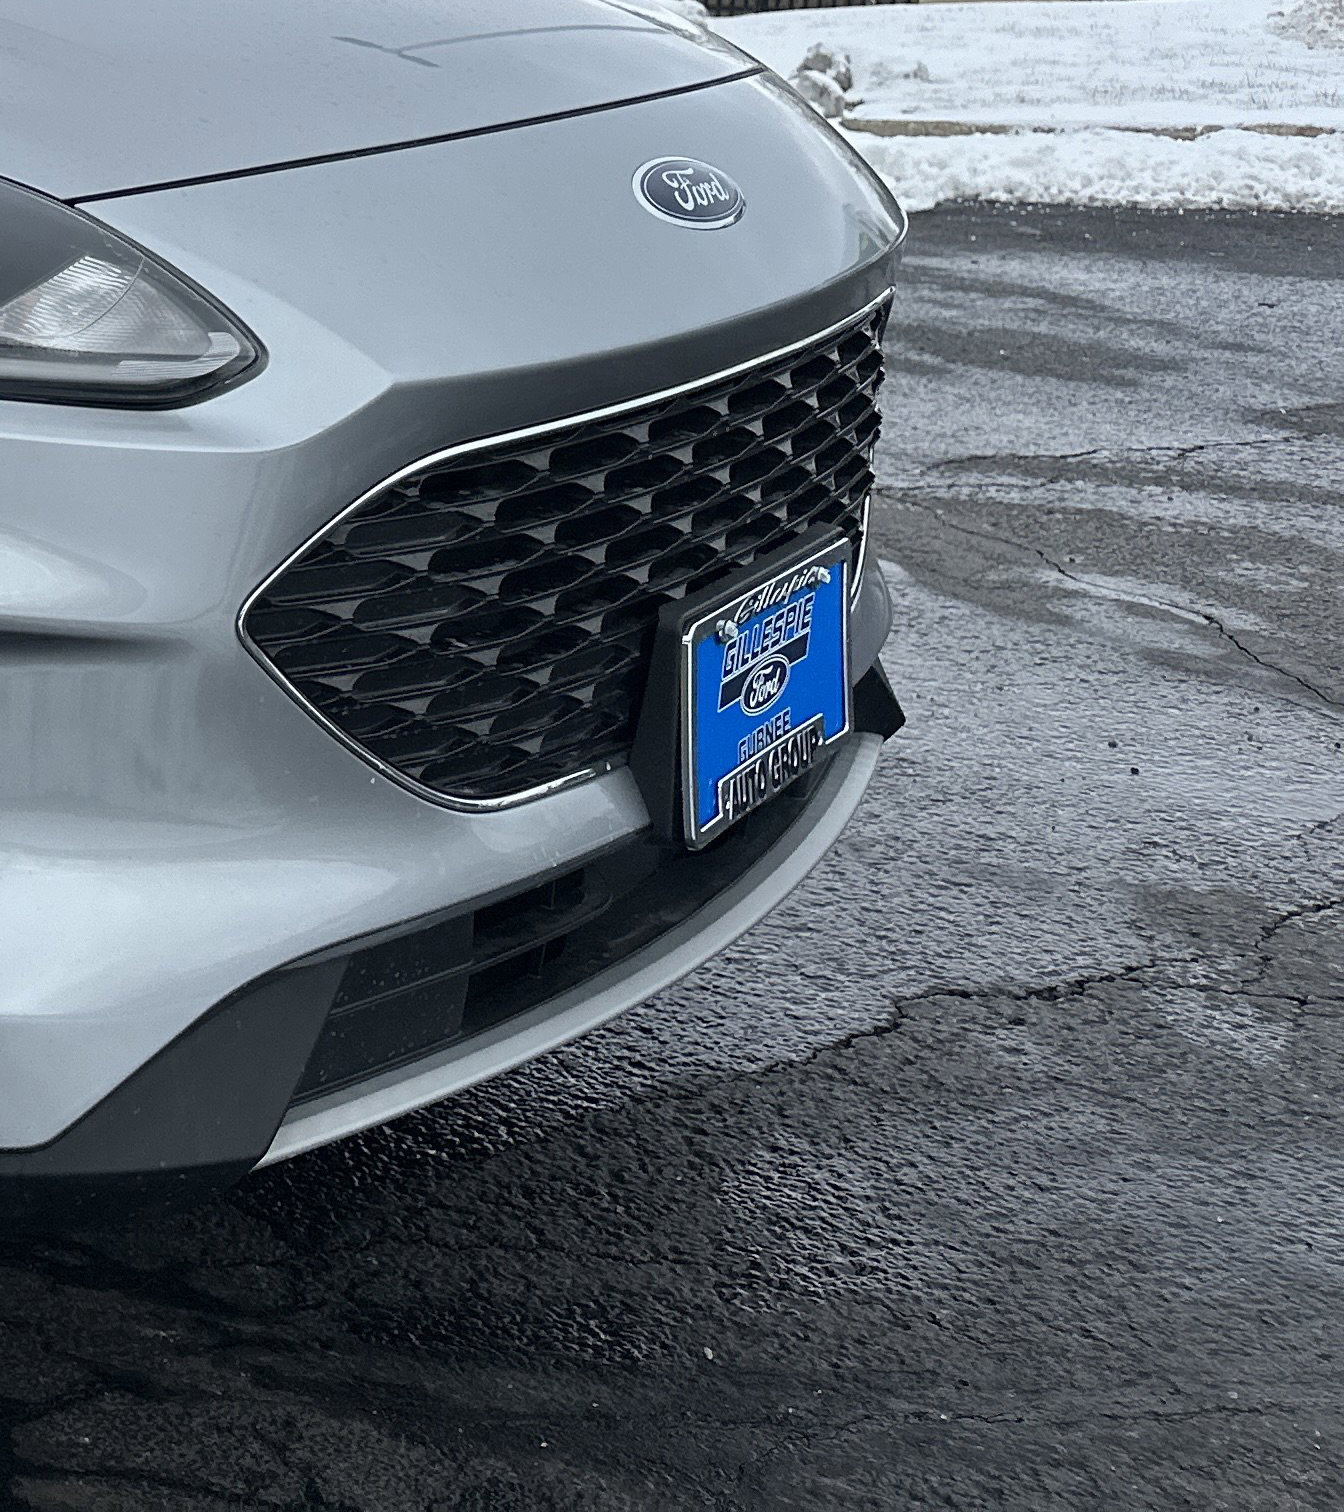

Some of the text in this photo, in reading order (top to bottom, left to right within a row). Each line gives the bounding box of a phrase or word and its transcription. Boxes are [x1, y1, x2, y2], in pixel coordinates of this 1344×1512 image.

[662, 167, 730, 211] Ford
[721, 591, 816, 681] GILLESPIE
[749, 664, 781, 708] Ford
[737, 706, 792, 765] GURNEE
[725, 724, 824, 820] AUTO GROUP
